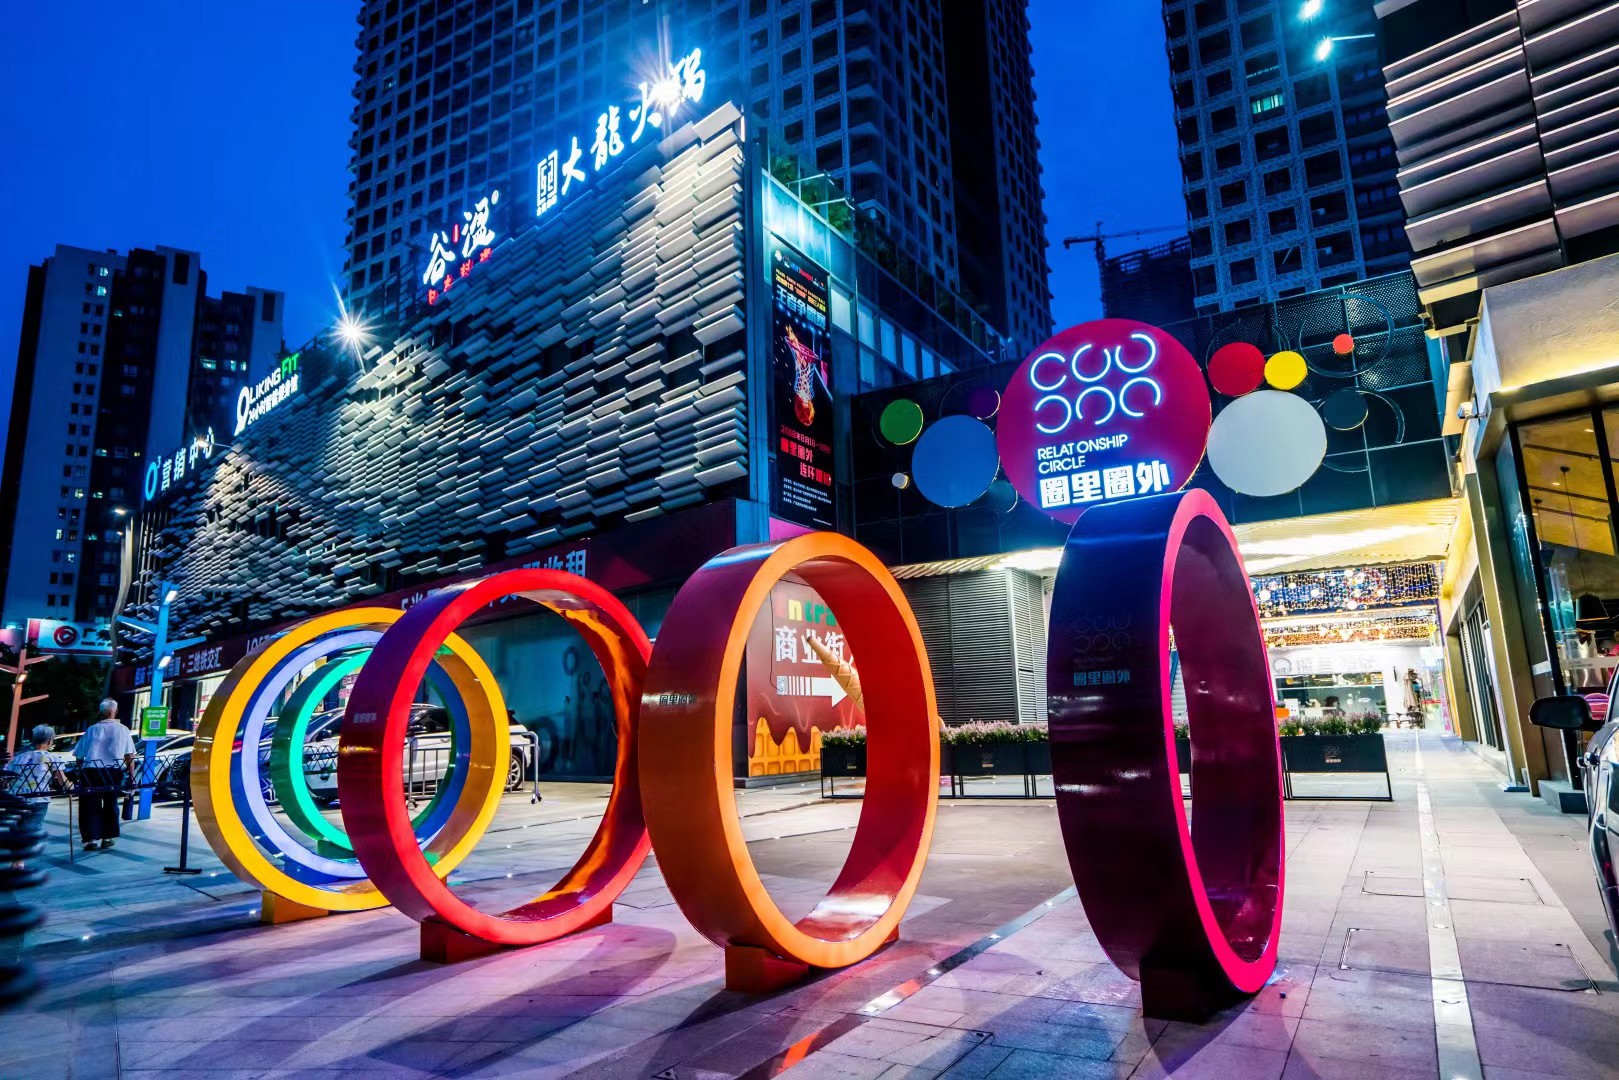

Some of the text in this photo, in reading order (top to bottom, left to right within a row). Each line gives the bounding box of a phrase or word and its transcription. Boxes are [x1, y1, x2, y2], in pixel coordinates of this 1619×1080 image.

[1038, 455, 1086, 475] CIRCLE
[1040, 460, 1170, 508] 圈里圈外
[775, 625, 845, 664] 商业街
